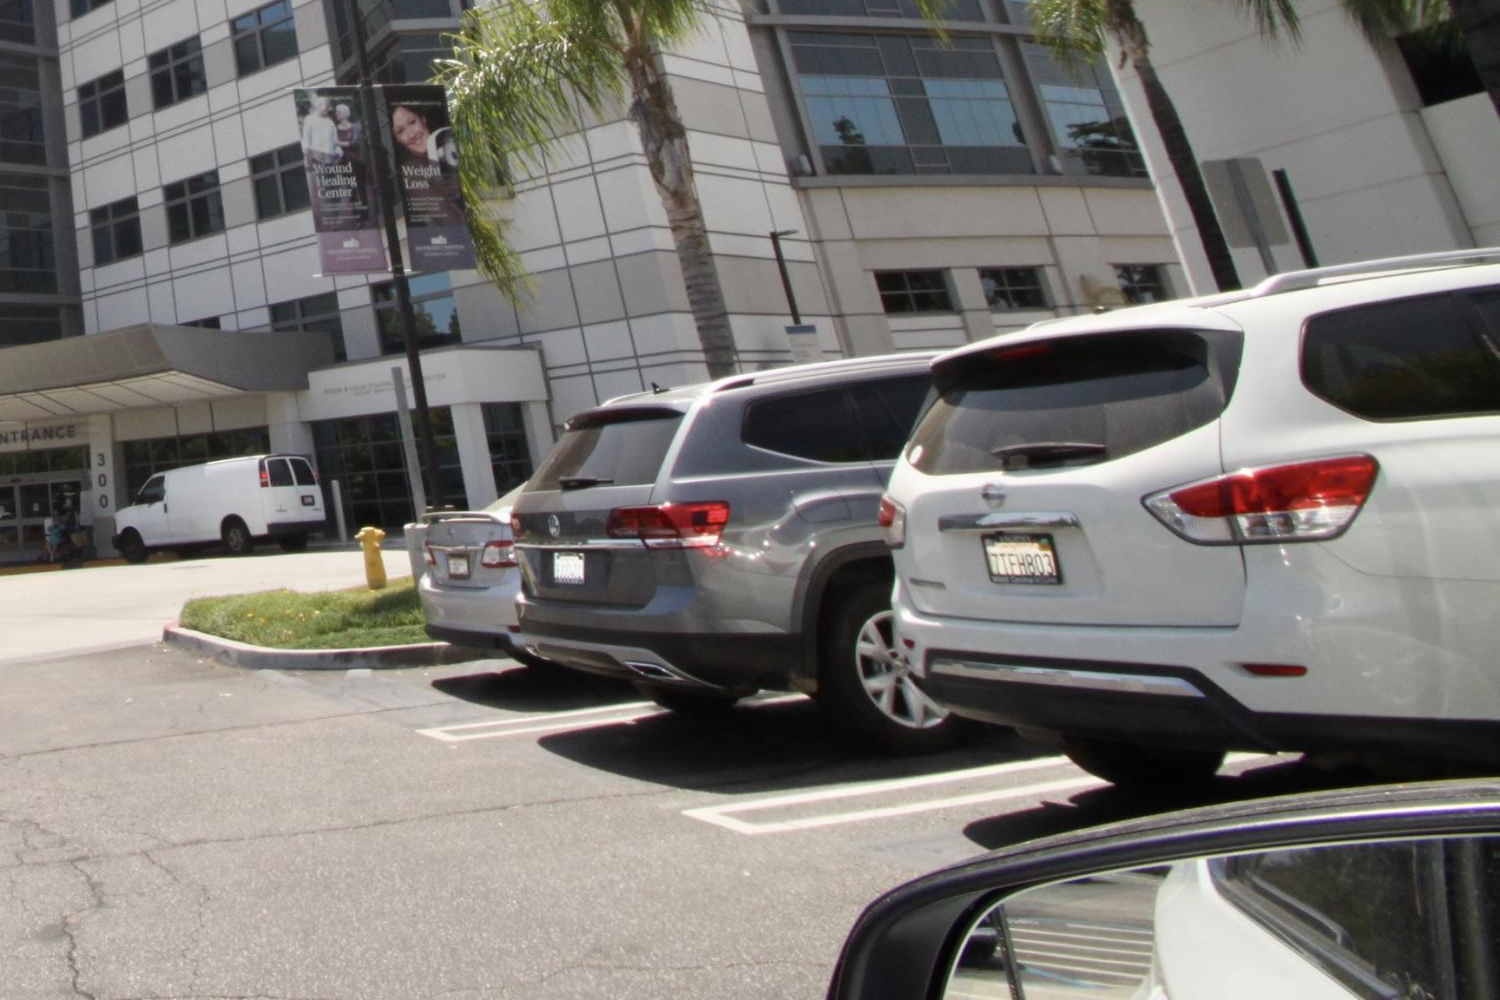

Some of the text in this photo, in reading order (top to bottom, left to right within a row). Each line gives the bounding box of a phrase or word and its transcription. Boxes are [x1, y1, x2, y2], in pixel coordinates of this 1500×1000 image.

[312, 161, 353, 174] Wound
[401, 164, 442, 179] Weight
[315, 174, 358, 188] Healing
[404, 178, 430, 190] Loss
[317, 187, 353, 199] Center
